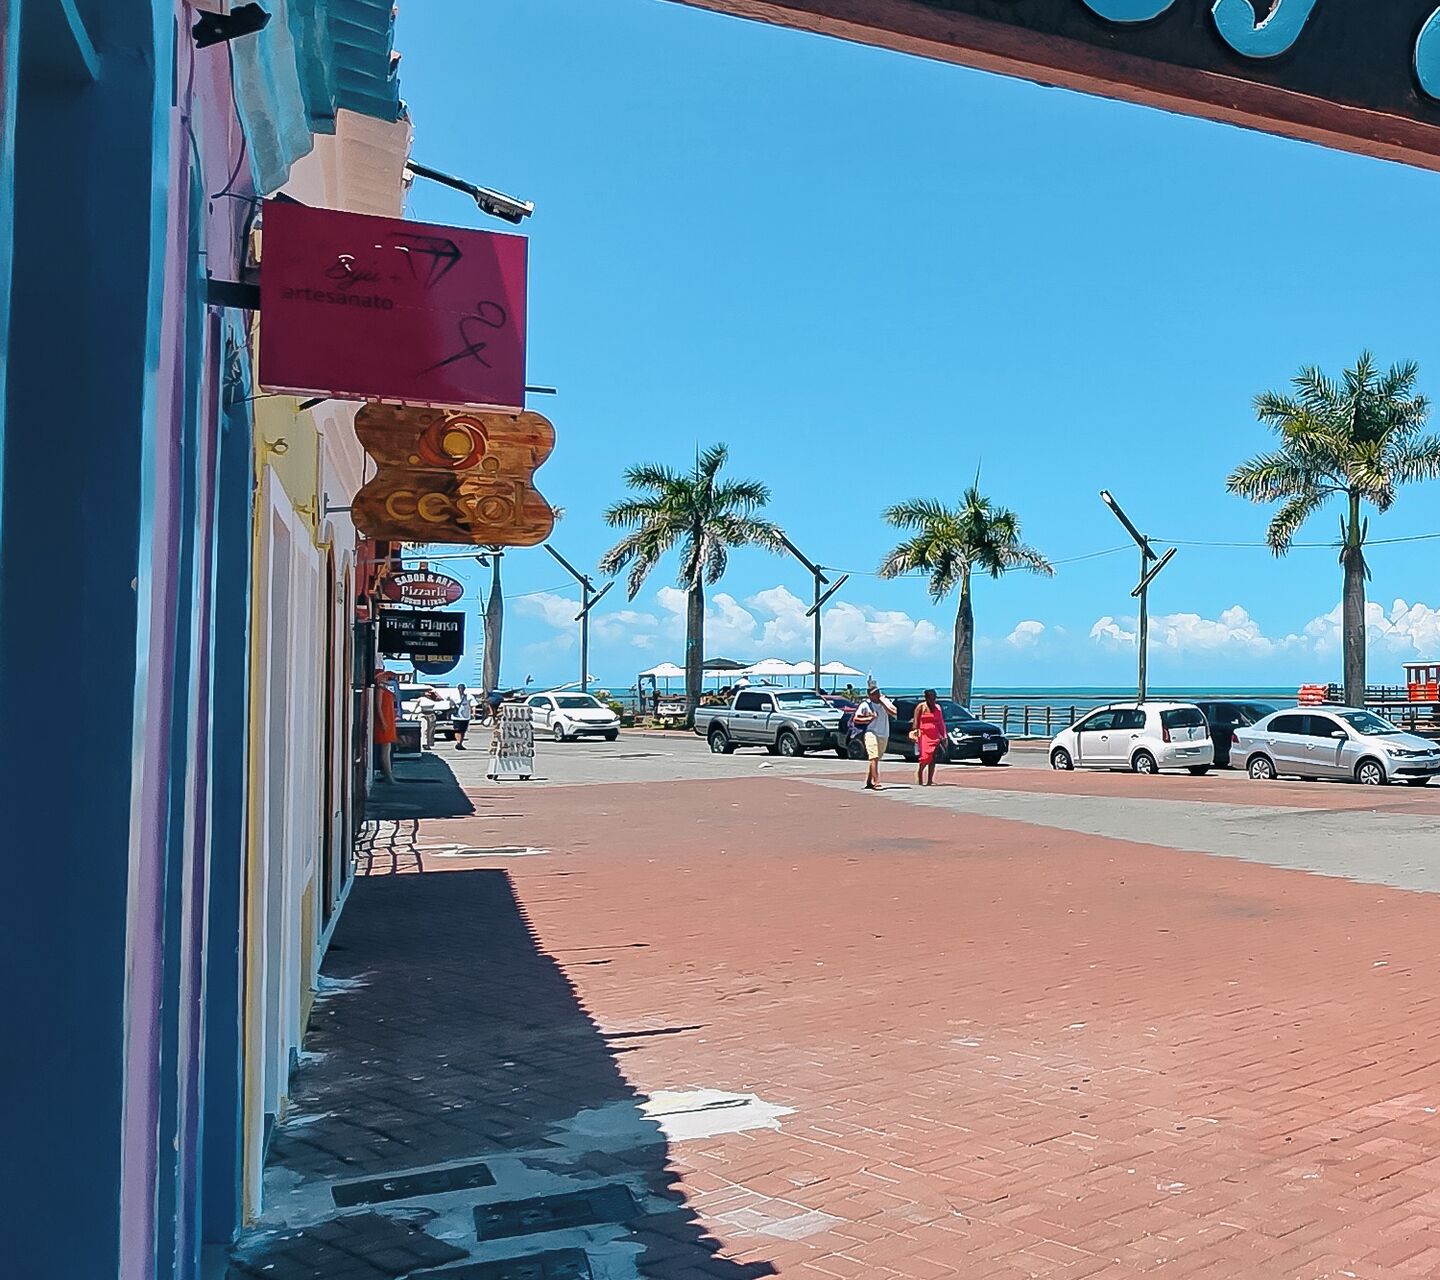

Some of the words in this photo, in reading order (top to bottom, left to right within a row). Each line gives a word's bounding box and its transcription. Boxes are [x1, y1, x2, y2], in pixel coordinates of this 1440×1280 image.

[281, 285, 394, 311] artesanato
[394, 573, 426, 586] SABOR
[427, 574, 435, 583] &
